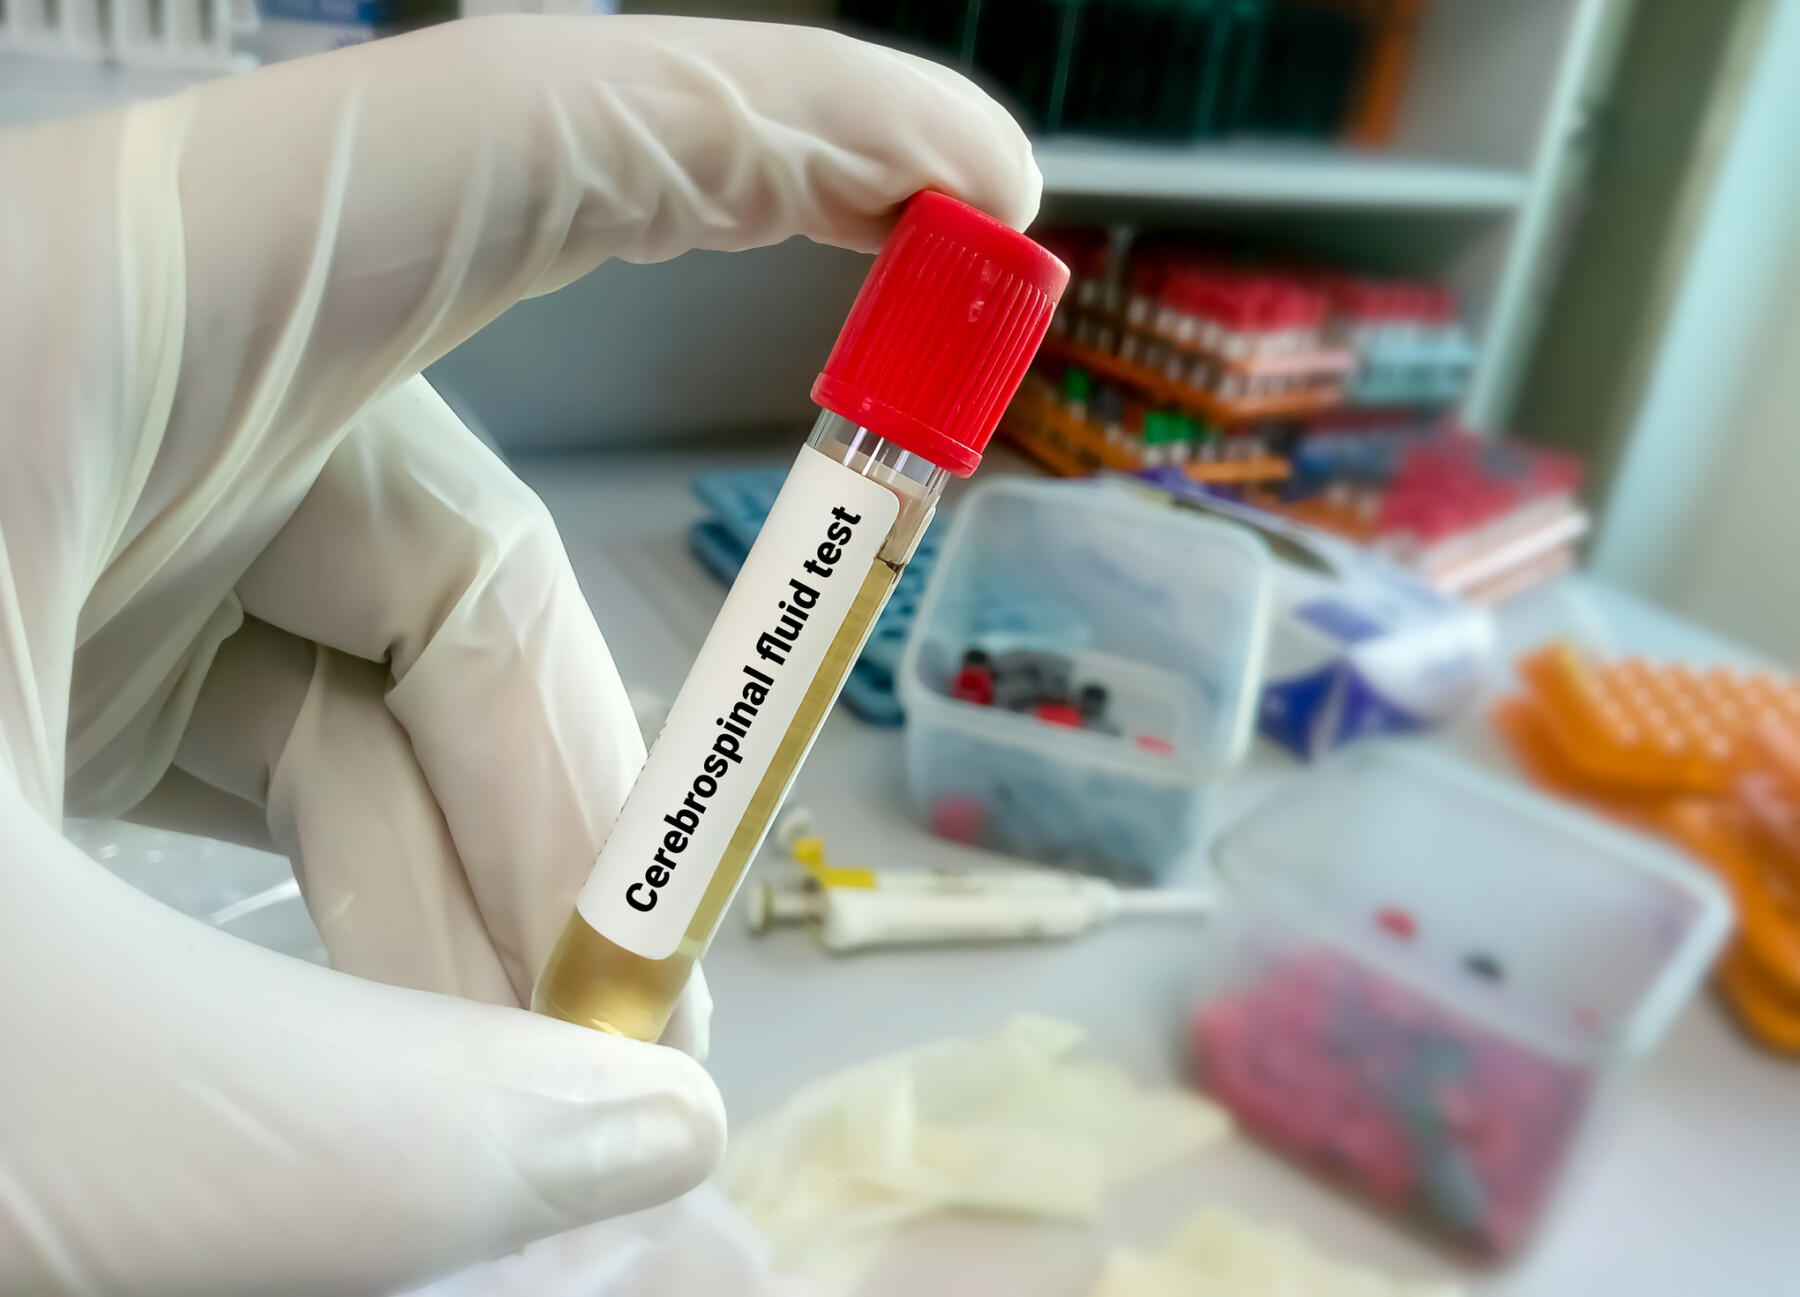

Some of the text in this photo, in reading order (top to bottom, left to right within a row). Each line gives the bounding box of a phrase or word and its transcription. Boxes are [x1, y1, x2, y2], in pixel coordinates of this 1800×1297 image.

[624, 505, 863, 913] Cerebrospinal fluid test
